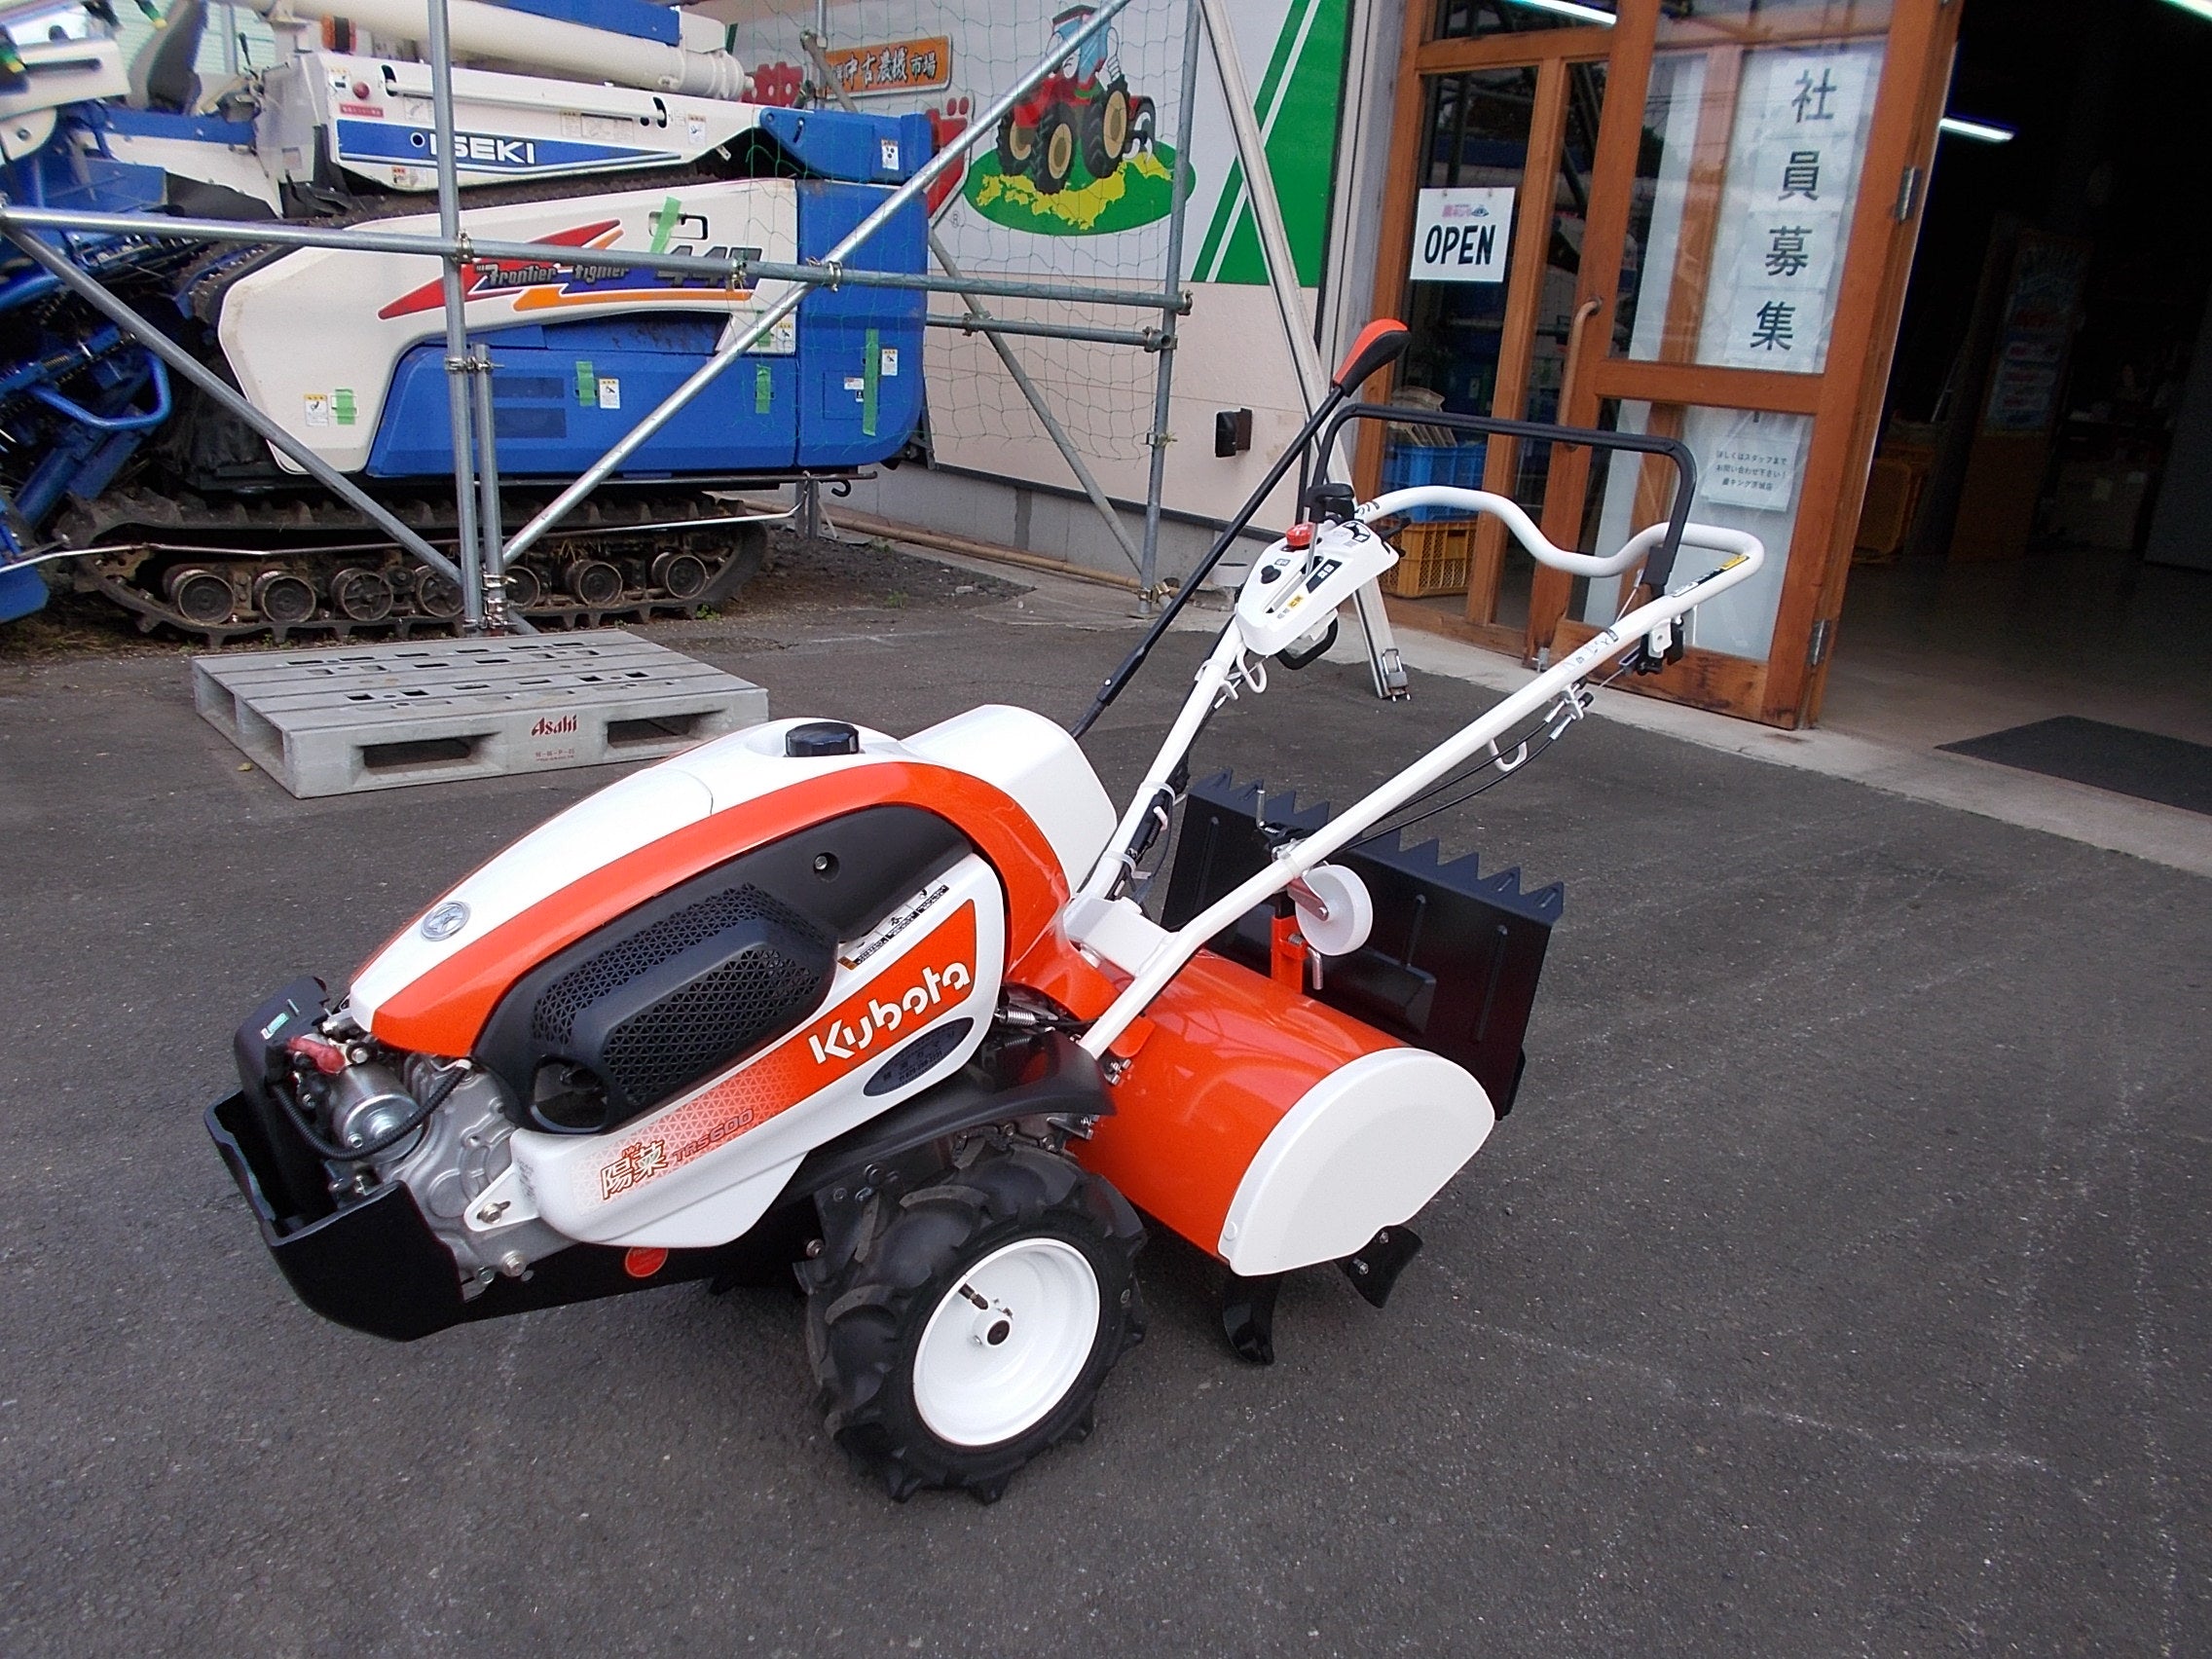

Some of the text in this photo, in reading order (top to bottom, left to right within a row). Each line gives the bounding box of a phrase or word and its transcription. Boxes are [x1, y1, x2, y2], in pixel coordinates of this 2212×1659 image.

[1750, 68, 1838, 351] 社員募集
[1424, 224, 1496, 265] OPEN
[531, 714, 577, 737] Asahi
[807, 962, 972, 1065] Kubota
[672, 1108, 755, 1162] TRS600
[601, 1139, 669, 1200] 陽菜
